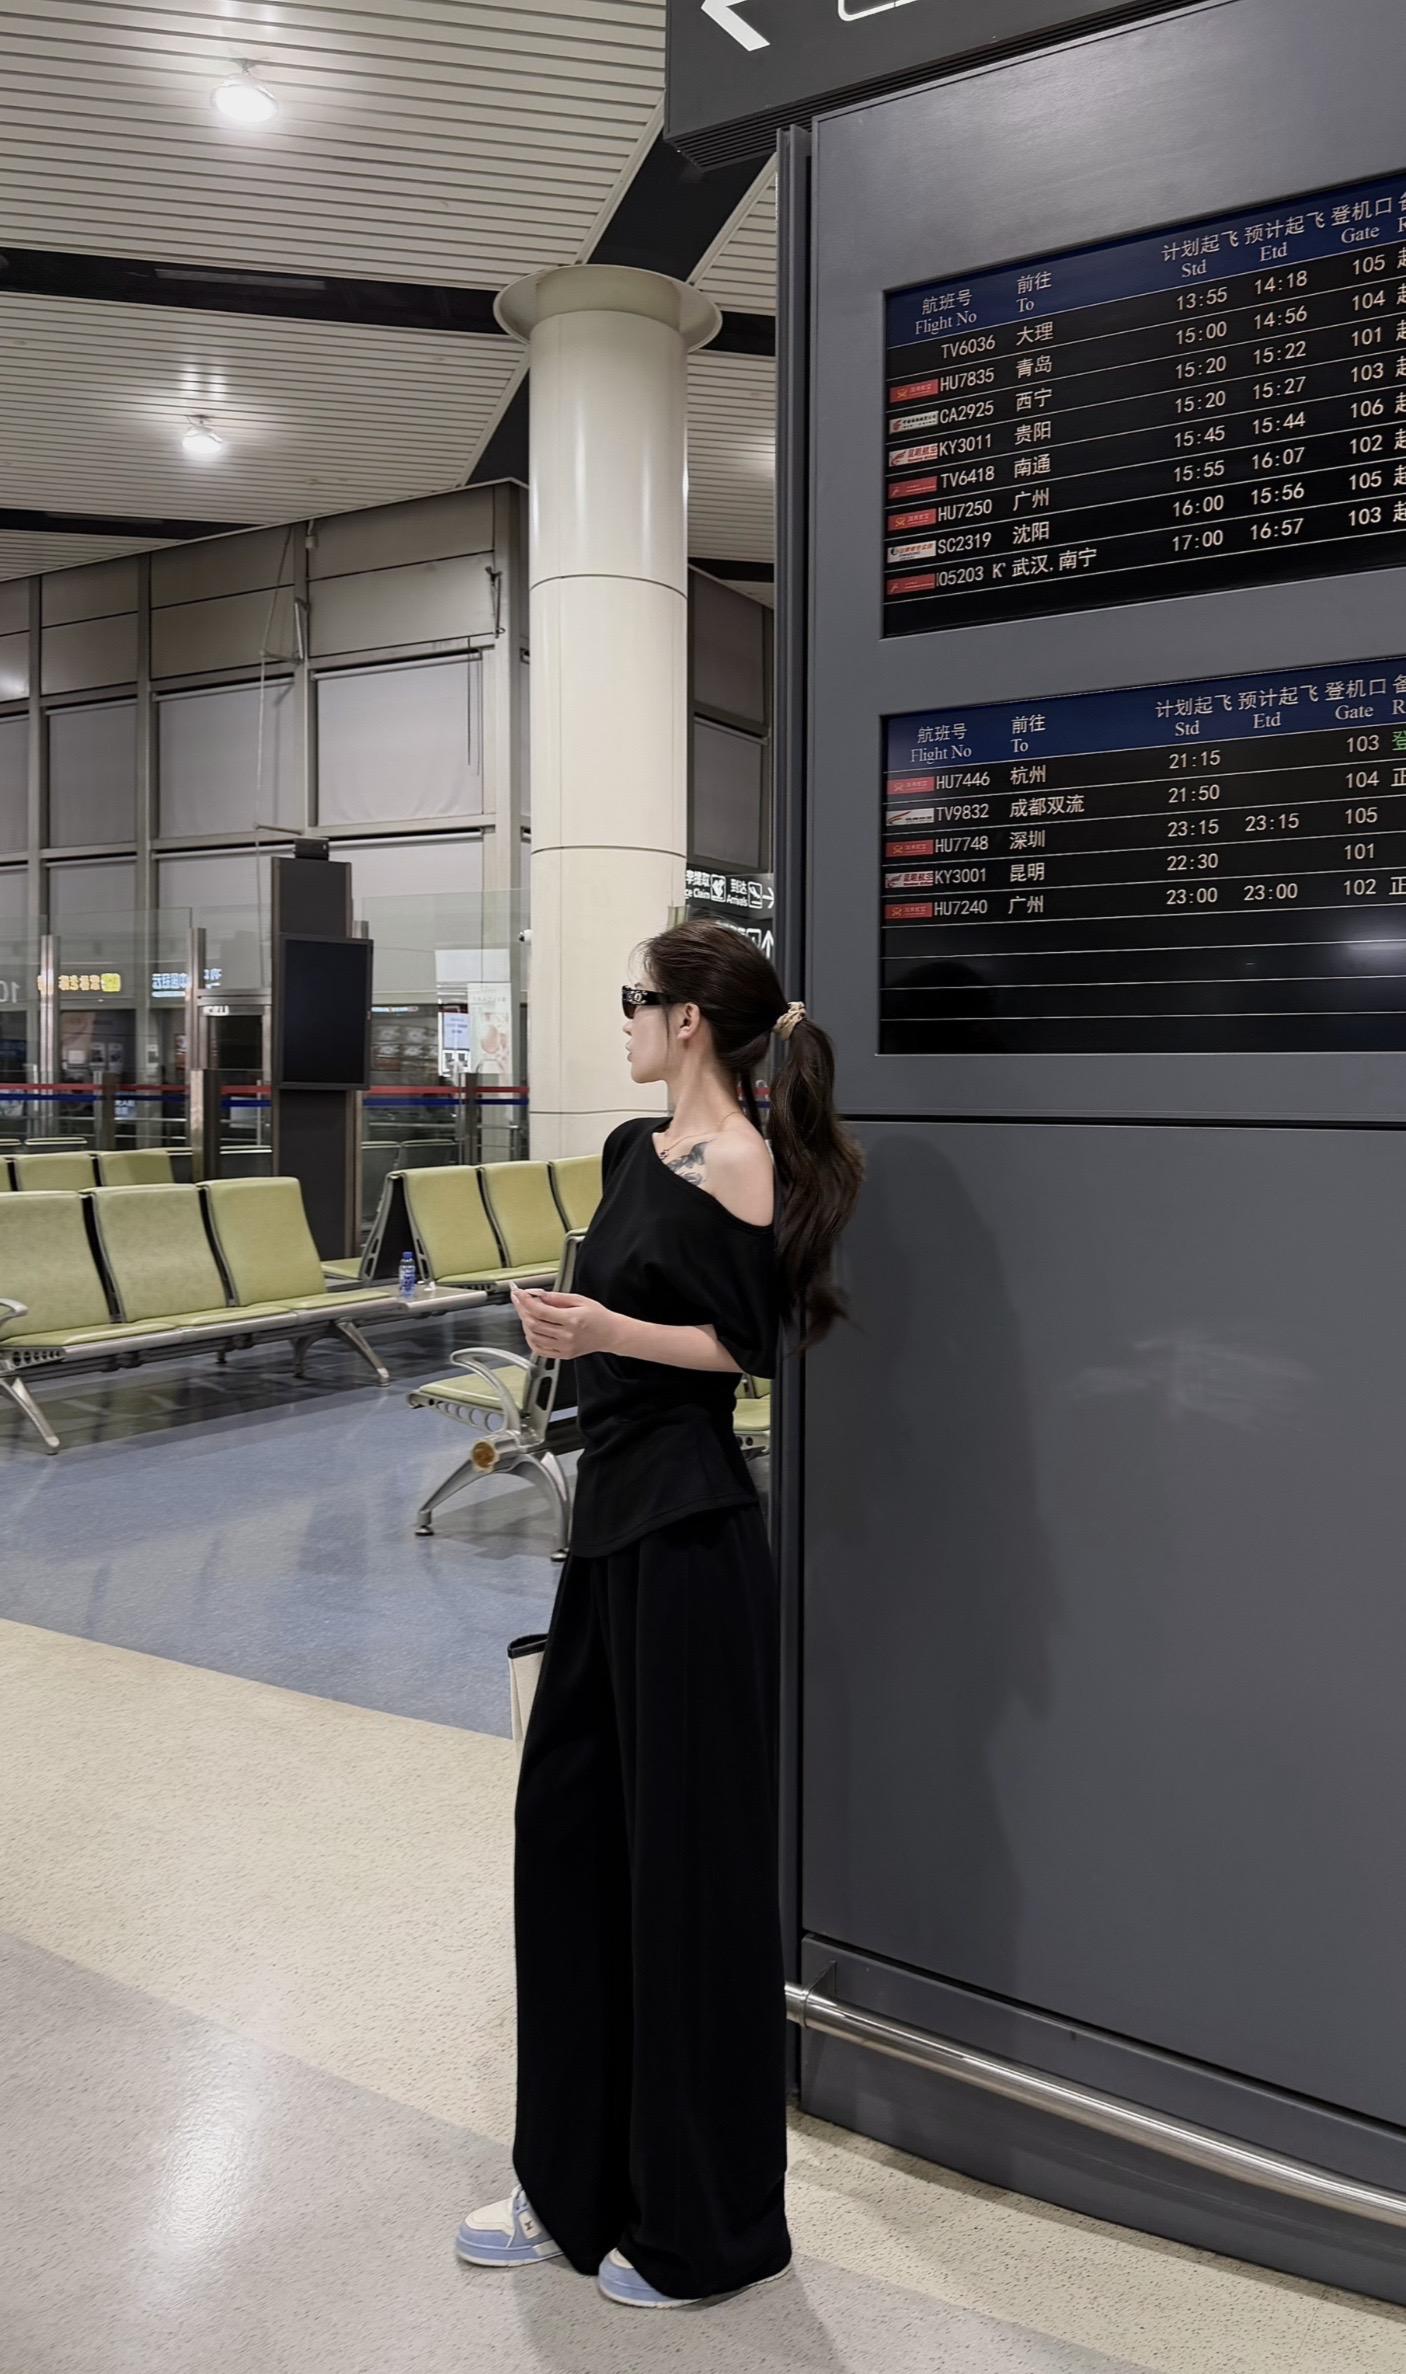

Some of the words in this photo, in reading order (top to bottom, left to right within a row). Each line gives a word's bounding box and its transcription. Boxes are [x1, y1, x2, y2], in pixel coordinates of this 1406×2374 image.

[915, 316, 952, 335] Flight
[956, 310, 977, 326] No
[1016, 298, 1035, 312] To
[1182, 259, 1207, 278] Std
[1260, 242, 1288, 262] Etd
[1341, 224, 1380, 243] Gate
[922, 288, 972, 314] 航班号
[1016, 271, 1052, 294] 前往
[1161, 230, 1239, 262] 计划起飞
[1244, 211, 1325, 245] 预计起飞
[1331, 197, 1392, 226] 登机口
[940, 367, 994, 392] HU7835
[1016, 355, 1052, 378] 青岛
[1176, 321, 1227, 344] 15:00
[1254, 305, 1308, 330] 14:56
[1352, 290, 1386, 311] 104
[941, 334, 996, 358] TV6036
[1016, 321, 1054, 346] 大理
[1177, 286, 1227, 310] 13:55
[1255, 270, 1307, 294] 14:18
[1352, 254, 1386, 275] 105
[939, 434, 991, 457] KY3011
[1014, 420, 1051, 445] 贵阳
[1175, 390, 1226, 413] 15:20
[1253, 376, 1306, 400] 15:27
[1351, 362, 1384, 382] 103
[940, 400, 994, 424] CA2925
[1015, 388, 1052, 412] 西宁
[1176, 356, 1226, 379] 15:20
[1253, 340, 1306, 364] 15:22
[1352, 327, 1381, 346] 101
[938, 499, 992, 522] HU7250
[1013, 487, 1049, 511] 广州
[1174, 460, 1224, 482] 15:55
[1252, 446, 1305, 470] 16:07
[1350, 434, 1383, 454] 102
[940, 465, 995, 488] TV6418
[1014, 453, 1051, 478] 南通
[1174, 425, 1225, 448] 15:45
[1252, 411, 1306, 434] 15:44
[1350, 398, 1384, 418] 106
[938, 532, 992, 554] SC2319
[1012, 521, 1050, 544] 沈阳
[1173, 494, 1224, 517] 16:00
[1251, 482, 1304, 505] 15:56
[1349, 470, 1382, 490] 105
[1172, 529, 1224, 551] 17:00
[1250, 518, 1304, 540] 16:57
[1348, 506, 1381, 526] 103
[910, 746, 948, 765] Flight
[951, 744, 972, 759] No
[1010, 738, 1029, 753] To
[1175, 720, 1200, 736] Std
[1253, 711, 1281, 729] Etd
[1335, 704, 1374, 720] Gate
[917, 723, 967, 744] 航班号
[1011, 714, 1046, 734] 前往
[1154, 694, 1233, 718] 计划起飞
[1238, 684, 1319, 710] 预计起飞
[1324, 678, 1386, 701] 登机口
[936, 771, 990, 790] HU7446
[1010, 764, 1046, 785] 杭州
[1169, 750, 1221, 769] 21:15
[1347, 734, 1379, 752] 103
[936, 803, 989, 821] TV9832
[1009, 794, 1085, 818] 成都双流
[1168, 784, 1220, 803] 21:50
[1346, 770, 1380, 788] 104
[934, 835, 989, 853] HU7748
[1009, 830, 1045, 850] 深圳
[1168, 818, 1219, 837] 23:15
[1245, 812, 1299, 832] 23:15
[1345, 806, 1378, 824] 105
[934, 868, 986, 884] KY3001
[1010, 862, 1045, 882] 昆明
[1167, 853, 1218, 871] 22:30
[1344, 843, 1374, 860] 101
[934, 899, 988, 916] HU7240
[1008, 895, 1044, 914] 广州
[1166, 887, 1218, 905] 23:00
[1244, 883, 1298, 901] 23:00
[1344, 878, 1376, 895] 102
